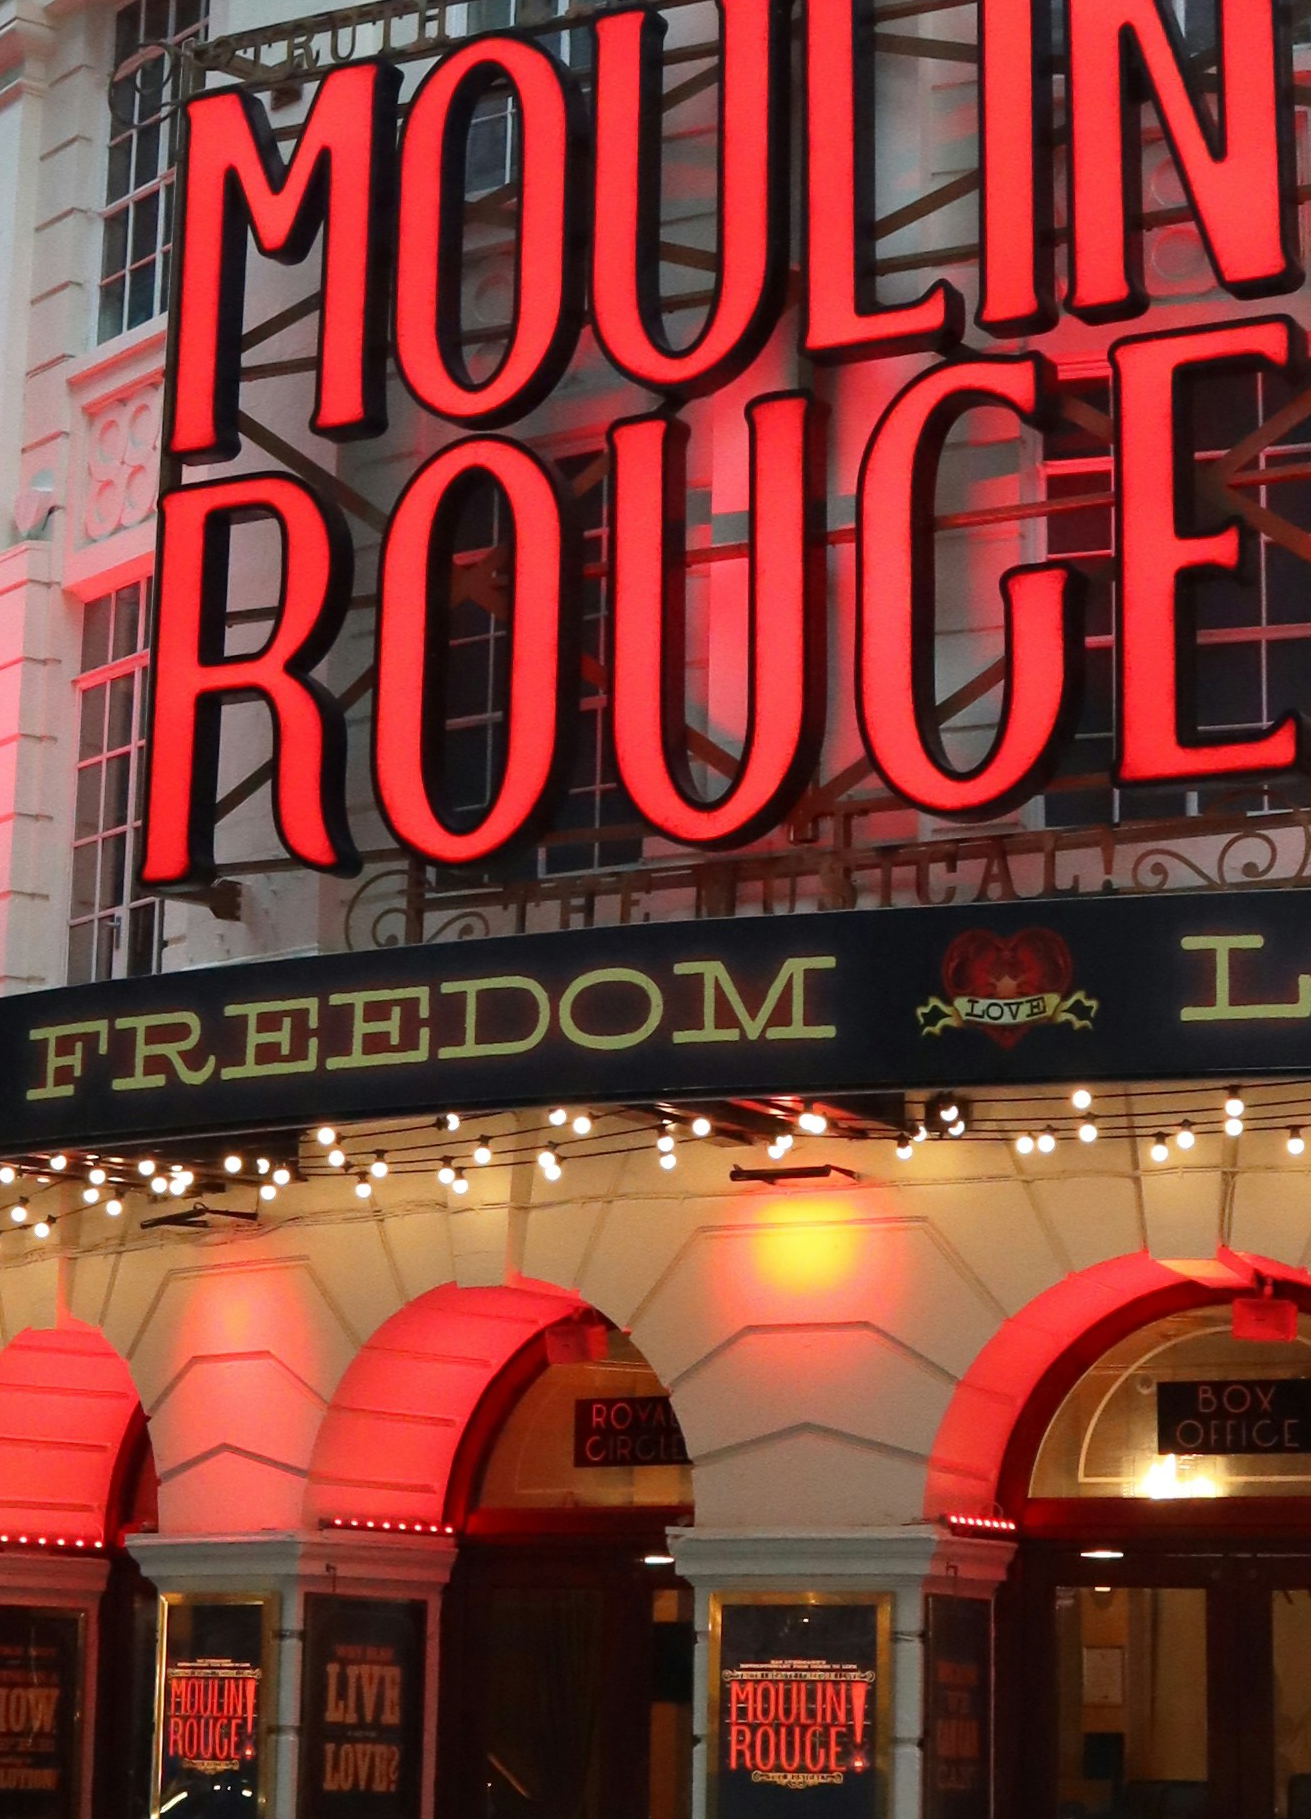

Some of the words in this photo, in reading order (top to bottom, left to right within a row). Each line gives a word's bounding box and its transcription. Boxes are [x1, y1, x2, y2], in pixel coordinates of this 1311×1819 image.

[965, 996, 1047, 1021] LOVE
[25, 956, 837, 1101] FREEDOM
[1198, 1384, 1276, 1413] BOX
[1177, 1419, 1301, 1449] OFFICE
[324, 1662, 402, 1726] LIVE
